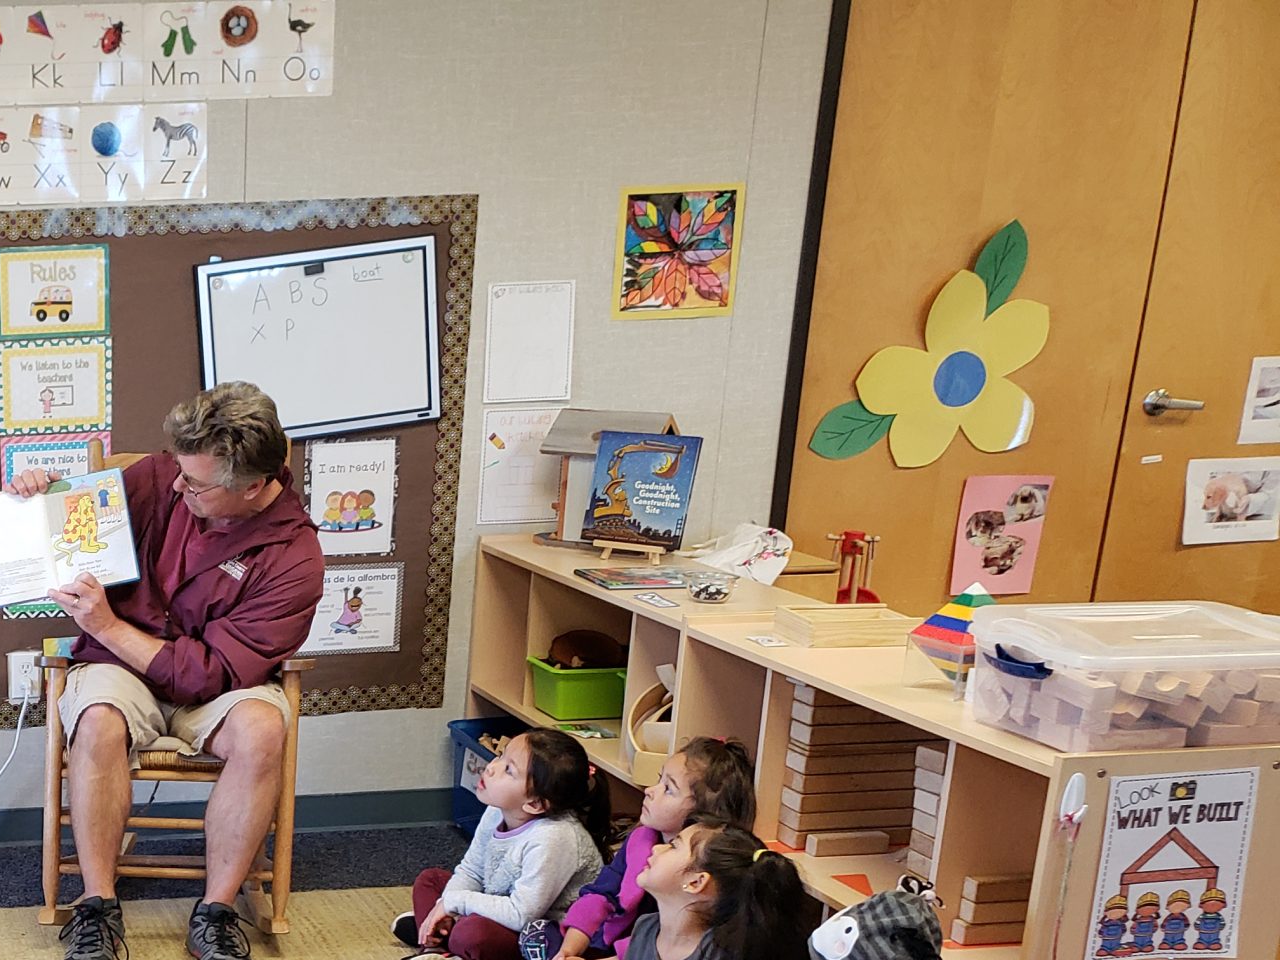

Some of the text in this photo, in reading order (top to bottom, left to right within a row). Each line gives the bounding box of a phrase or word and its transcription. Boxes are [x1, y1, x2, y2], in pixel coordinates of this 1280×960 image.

[32, 64, 63, 89] Kk
[152, 61, 200, 87] Mm
[222, 59, 256, 84] Nn
[284, 57, 320, 82] Oo
[33, 164, 66, 188] Xx
[98, 161, 128, 196] Yy
[161, 160, 192, 185] Zz
[30, 261, 77, 283] Rules
[353, 263, 382, 281] boat
[252, 277, 329, 314] A B S
[285, 318, 295, 341] P
[20, 358, 89, 371] We listen to the
[37, 373, 73, 383] teachers
[26, 454, 88, 465] We are nice to
[318, 460, 386, 474] I am ready!
[634, 480, 676, 493] Goodnight,
[639, 489, 680, 501] Goodnight,
[632, 496, 680, 509] Construction
[645, 505, 661, 515] Site
[333, 575, 345, 583] de
[347, 574, 355, 582] la
[357, 573, 396, 582] alfombra
[1118, 782, 1162, 810] LOOK
[1116, 800, 1244, 830] WHAT WE BUILT
